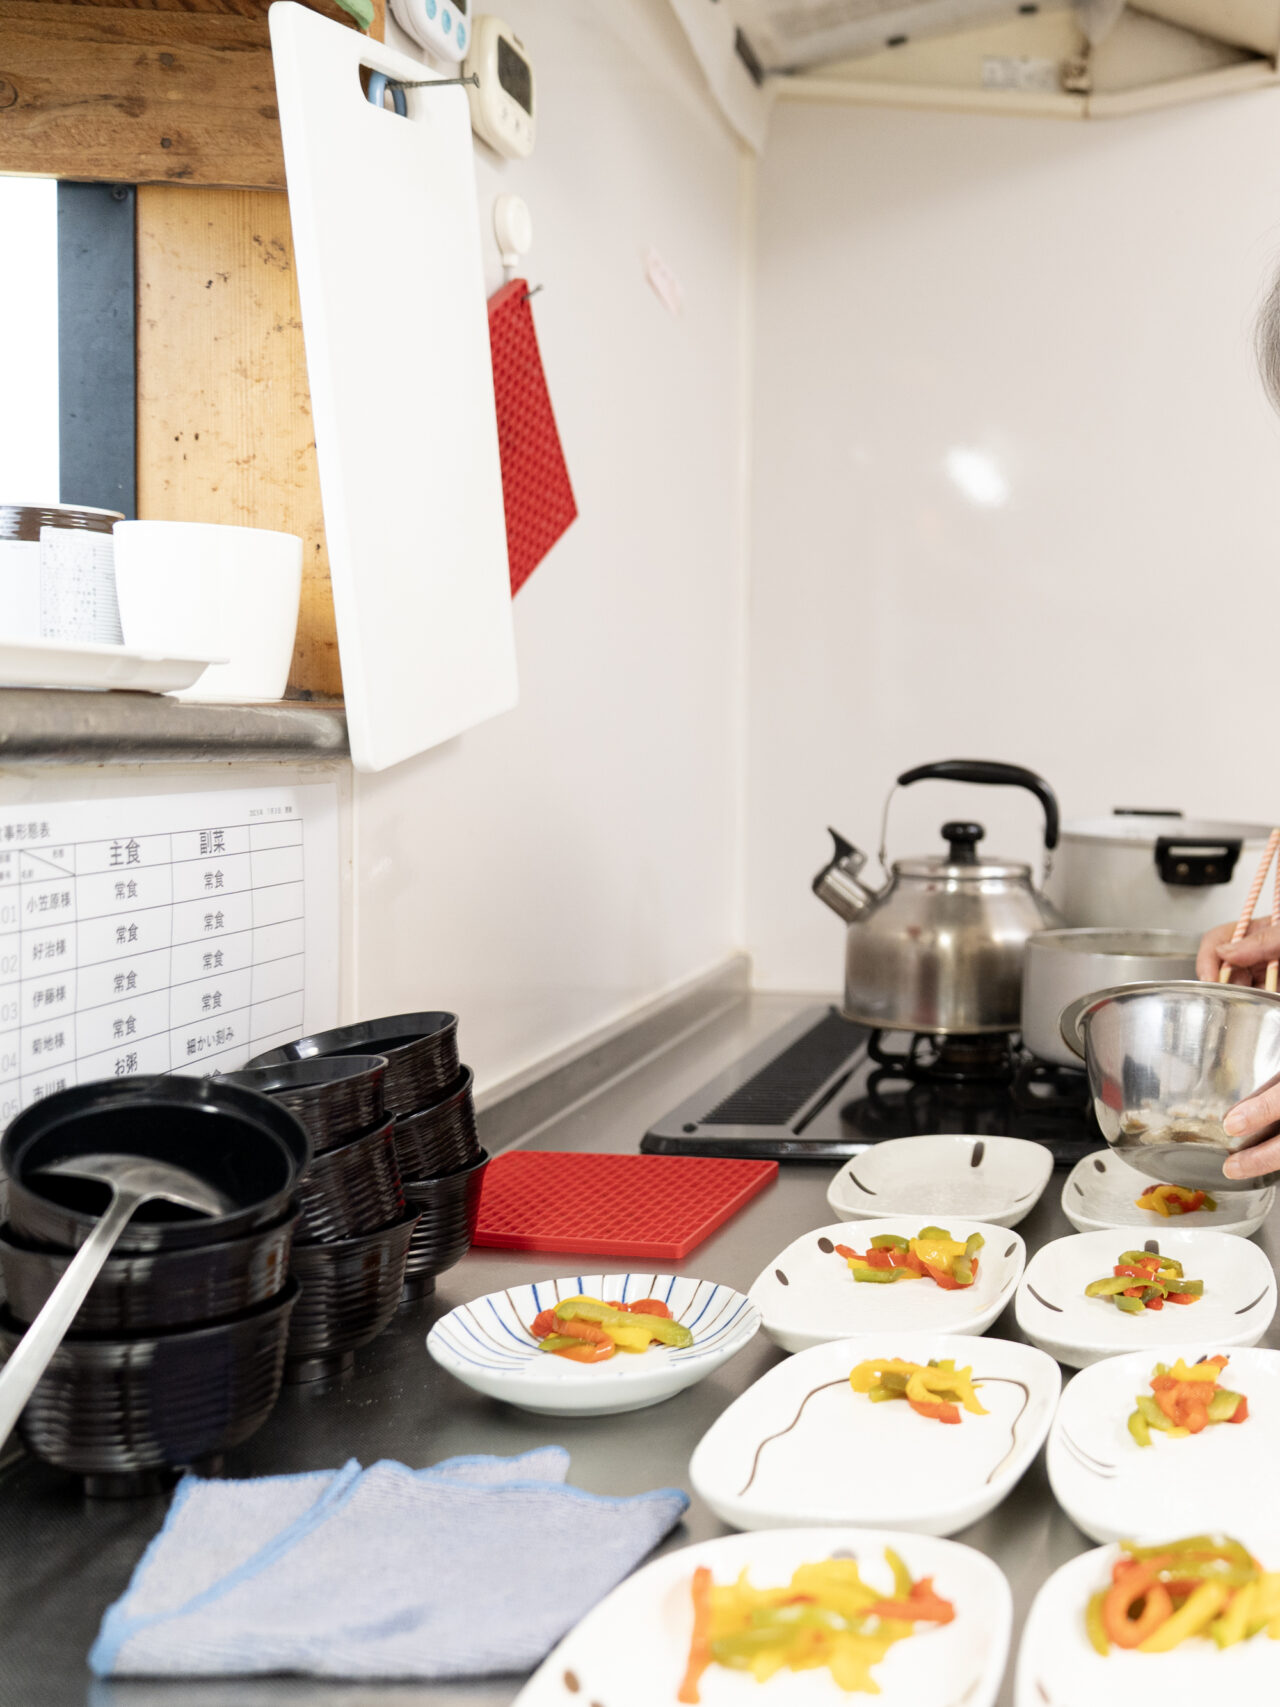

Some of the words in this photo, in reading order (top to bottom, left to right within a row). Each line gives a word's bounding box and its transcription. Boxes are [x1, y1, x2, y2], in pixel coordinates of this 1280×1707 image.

[0, 822, 50, 841] 事形態表
[199, 830, 226, 855] 副菜
[109, 838, 141, 866] 主食
[115, 879, 138, 899] 常食
[204, 870, 224, 889] 常食
[26, 891, 71, 914] 小笠原様
[204, 911, 224, 931] 常食
[116, 922, 139, 944] 常食
[202, 949, 224, 970] 常食
[114, 970, 138, 993] 常食
[201, 990, 222, 1012] 常食
[113, 1015, 137, 1039] 常食
[114, 1052, 138, 1076] お粥
